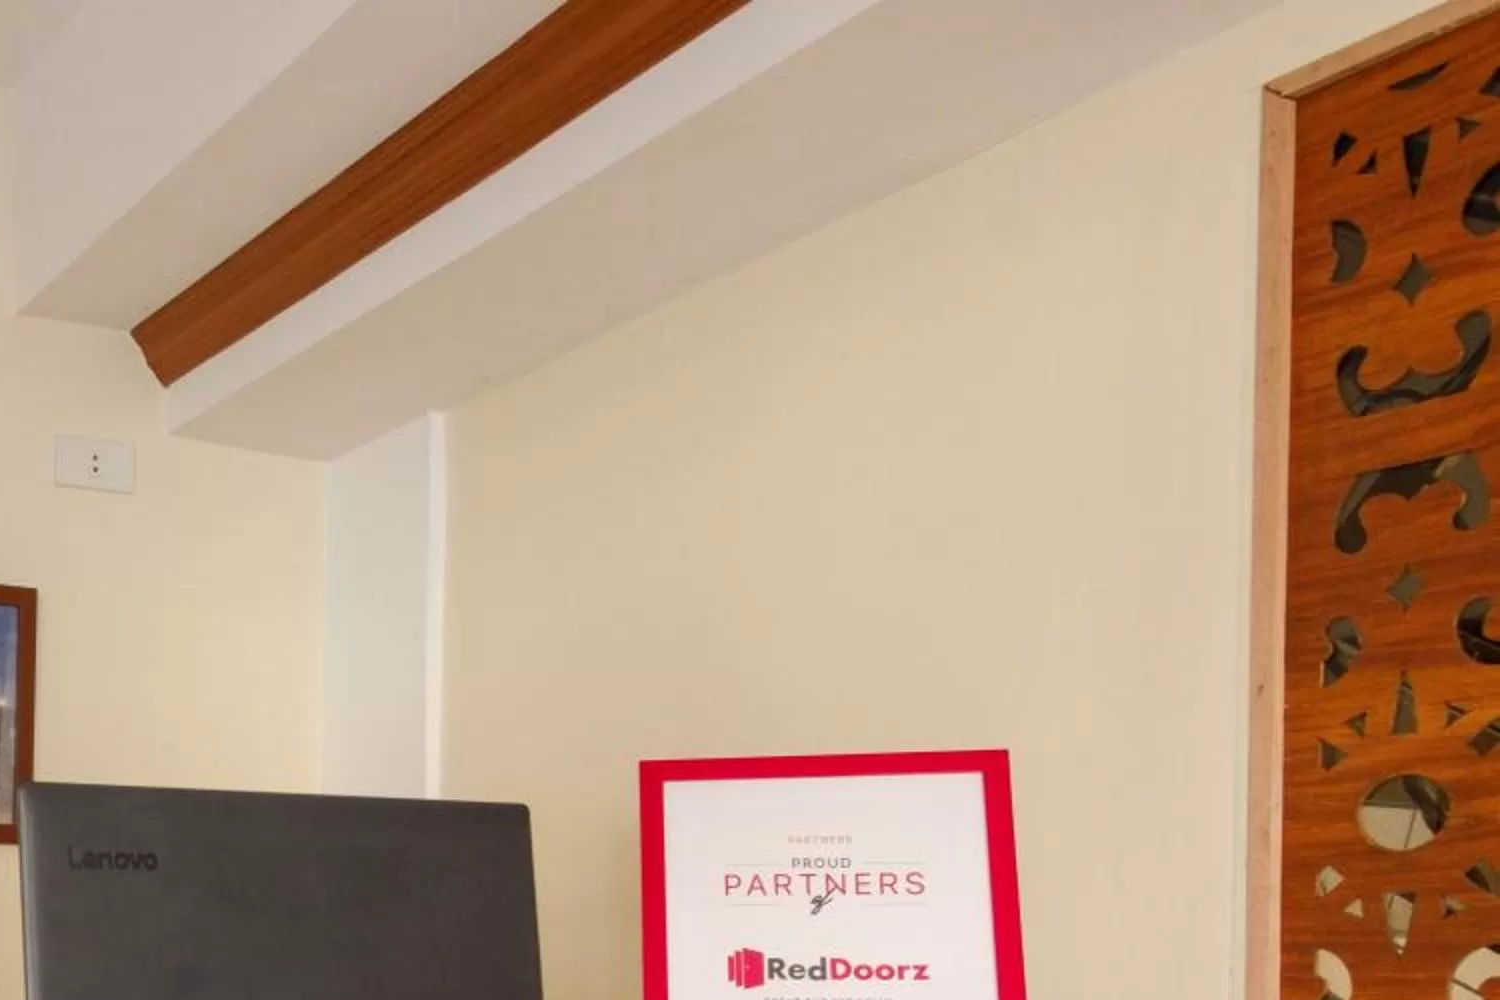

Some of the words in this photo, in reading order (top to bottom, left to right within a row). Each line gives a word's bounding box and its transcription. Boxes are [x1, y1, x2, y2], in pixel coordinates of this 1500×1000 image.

[67, 845, 159, 871] Lenovo
[791, 856, 852, 869] PROUD
[724, 872, 926, 896] PARTNERS
[767, 957, 930, 981] RedDoorz
